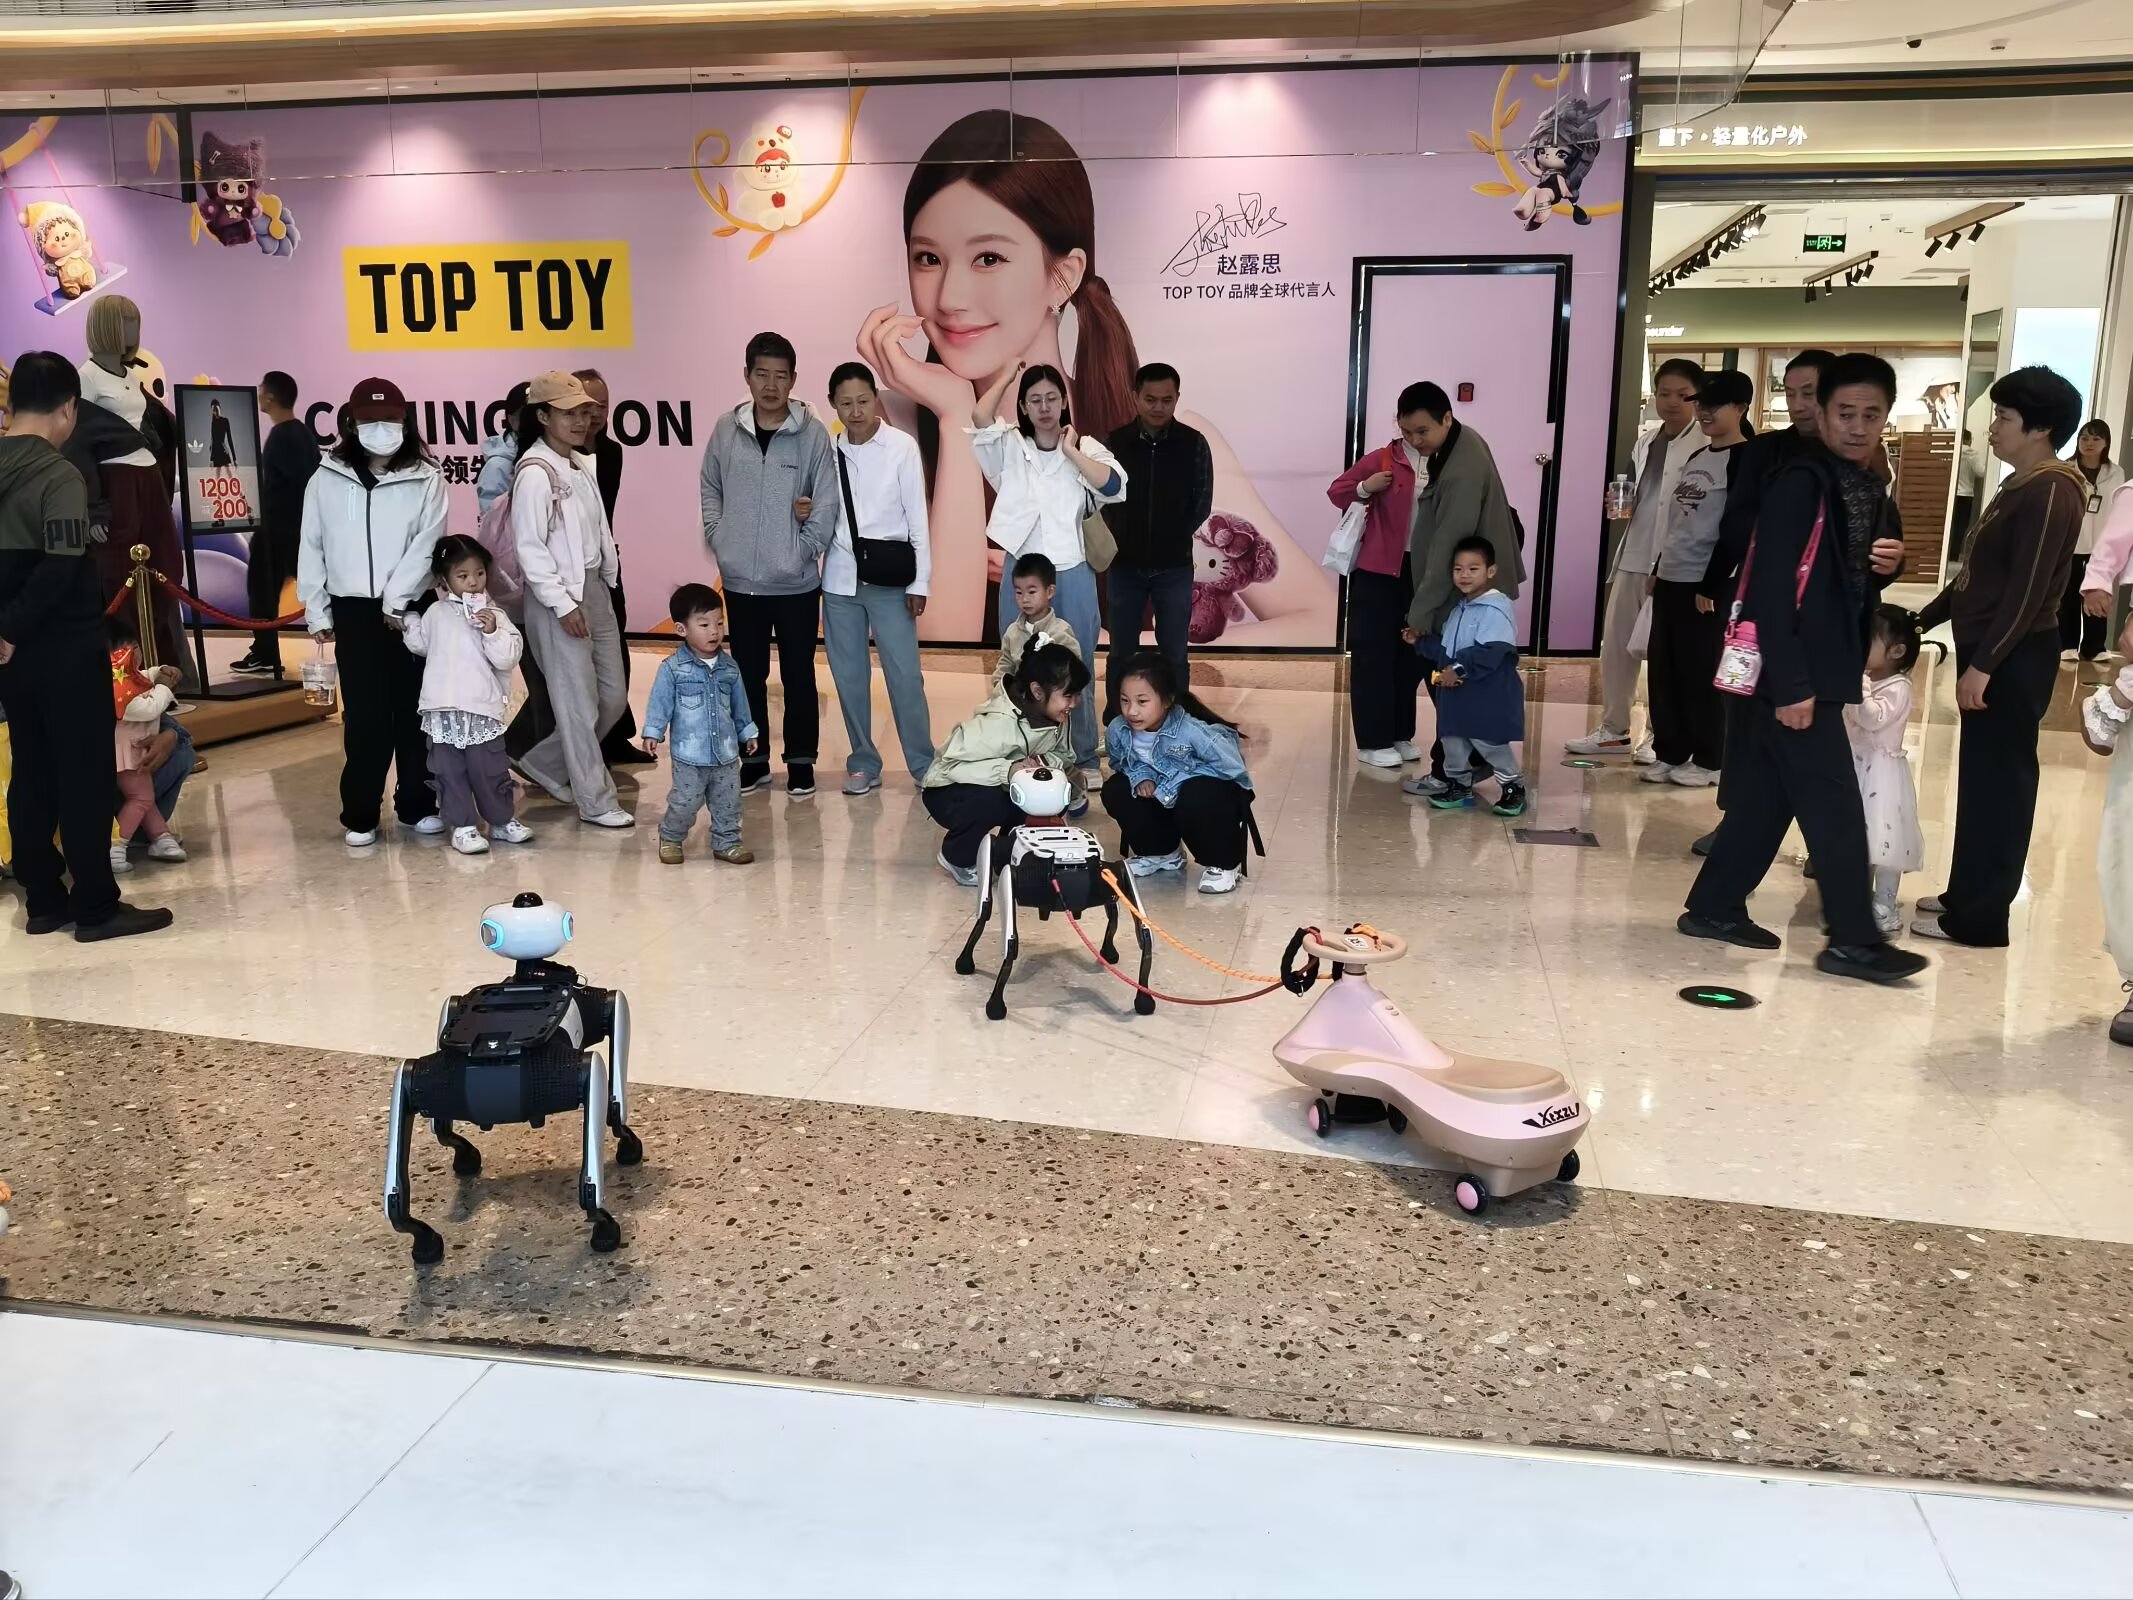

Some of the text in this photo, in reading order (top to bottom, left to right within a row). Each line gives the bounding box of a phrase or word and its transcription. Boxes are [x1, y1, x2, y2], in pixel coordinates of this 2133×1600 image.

[1658, 125, 1808, 147] 下·轻量化户外
[1217, 253, 1282, 276] 赵露思
[359, 258, 613, 334] TOP TOY
[1163, 281, 1336, 300] TOP TOY 品牌全球代言人
[199, 477, 241, 498] 1200
[213, 499, 247, 519] 200
